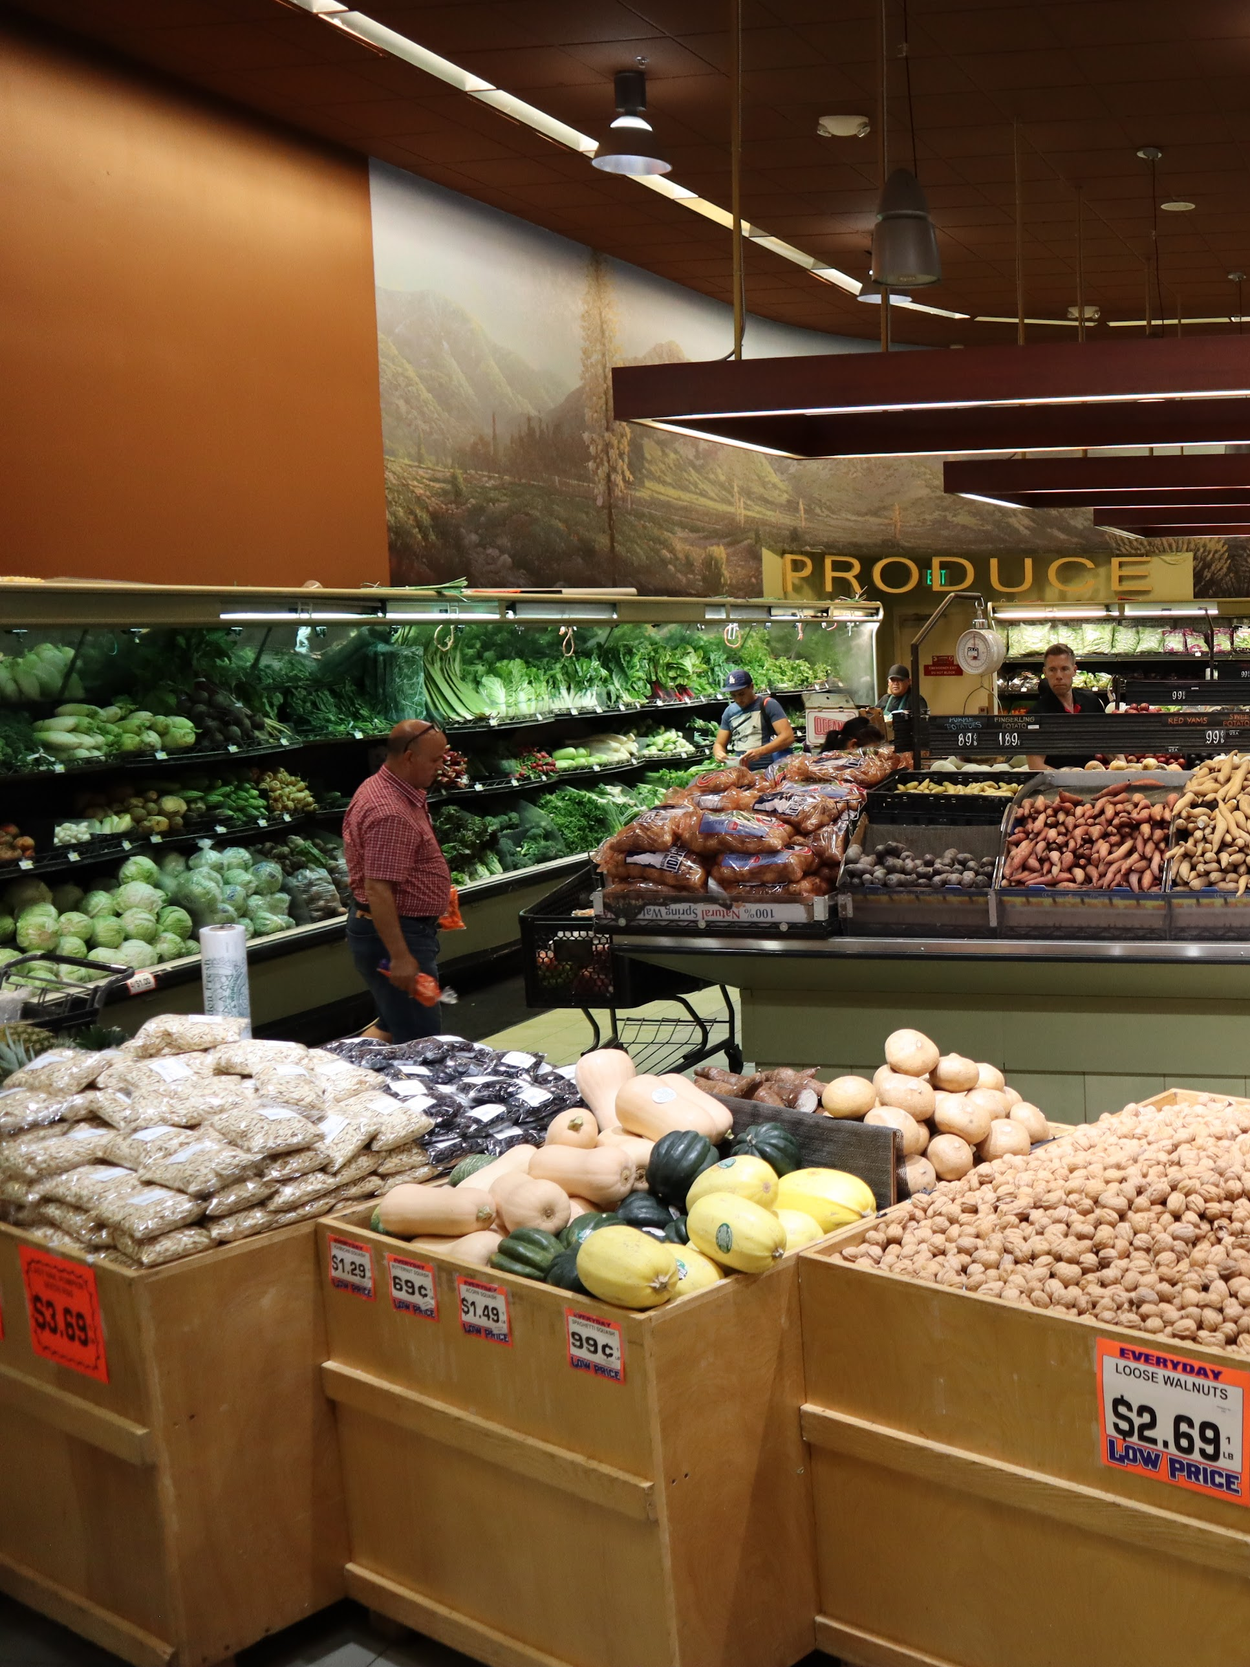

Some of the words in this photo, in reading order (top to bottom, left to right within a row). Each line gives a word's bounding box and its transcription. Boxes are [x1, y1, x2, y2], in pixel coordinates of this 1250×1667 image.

[782, 554, 1153, 593] PRODUCE
[927, 569, 947, 585] ET
[1168, 717, 1184, 725] RED
[1187, 717, 1208, 725] YAMS
[665, 906, 699, 919] Spring
[702, 908, 741, 920] Natural
[743, 908, 775, 919] 100%
[331, 1254, 366, 1279] $1.29
[351, 1284, 373, 1298] PRICE
[392, 1275, 428, 1299] 69¢
[33, 1294, 89, 1348] $3.69
[412, 1304, 436, 1319] PRICE
[461, 1297, 500, 1324] $1.49
[463, 1322, 482, 1335] LOW
[485, 1327, 510, 1343] PRICE
[571, 1318, 596, 1331] SPAGHETTI
[596, 1326, 616, 1337] SQUASH
[570, 1331, 614, 1360] 99¢
[570, 1354, 591, 1370] LOW
[593, 1363, 621, 1381] PRICE
[1119, 1347, 1223, 1381] EVERYDAY
[1115, 1362, 1159, 1384] LOOSE
[1162, 1374, 1228, 1400] WALNUTS
[1112, 1394, 1221, 1463] $2.69
[1107, 1437, 1162, 1471] LOW
[1167, 1455, 1242, 1496] PRICE
[1222, 1451, 1234, 1461] LB
